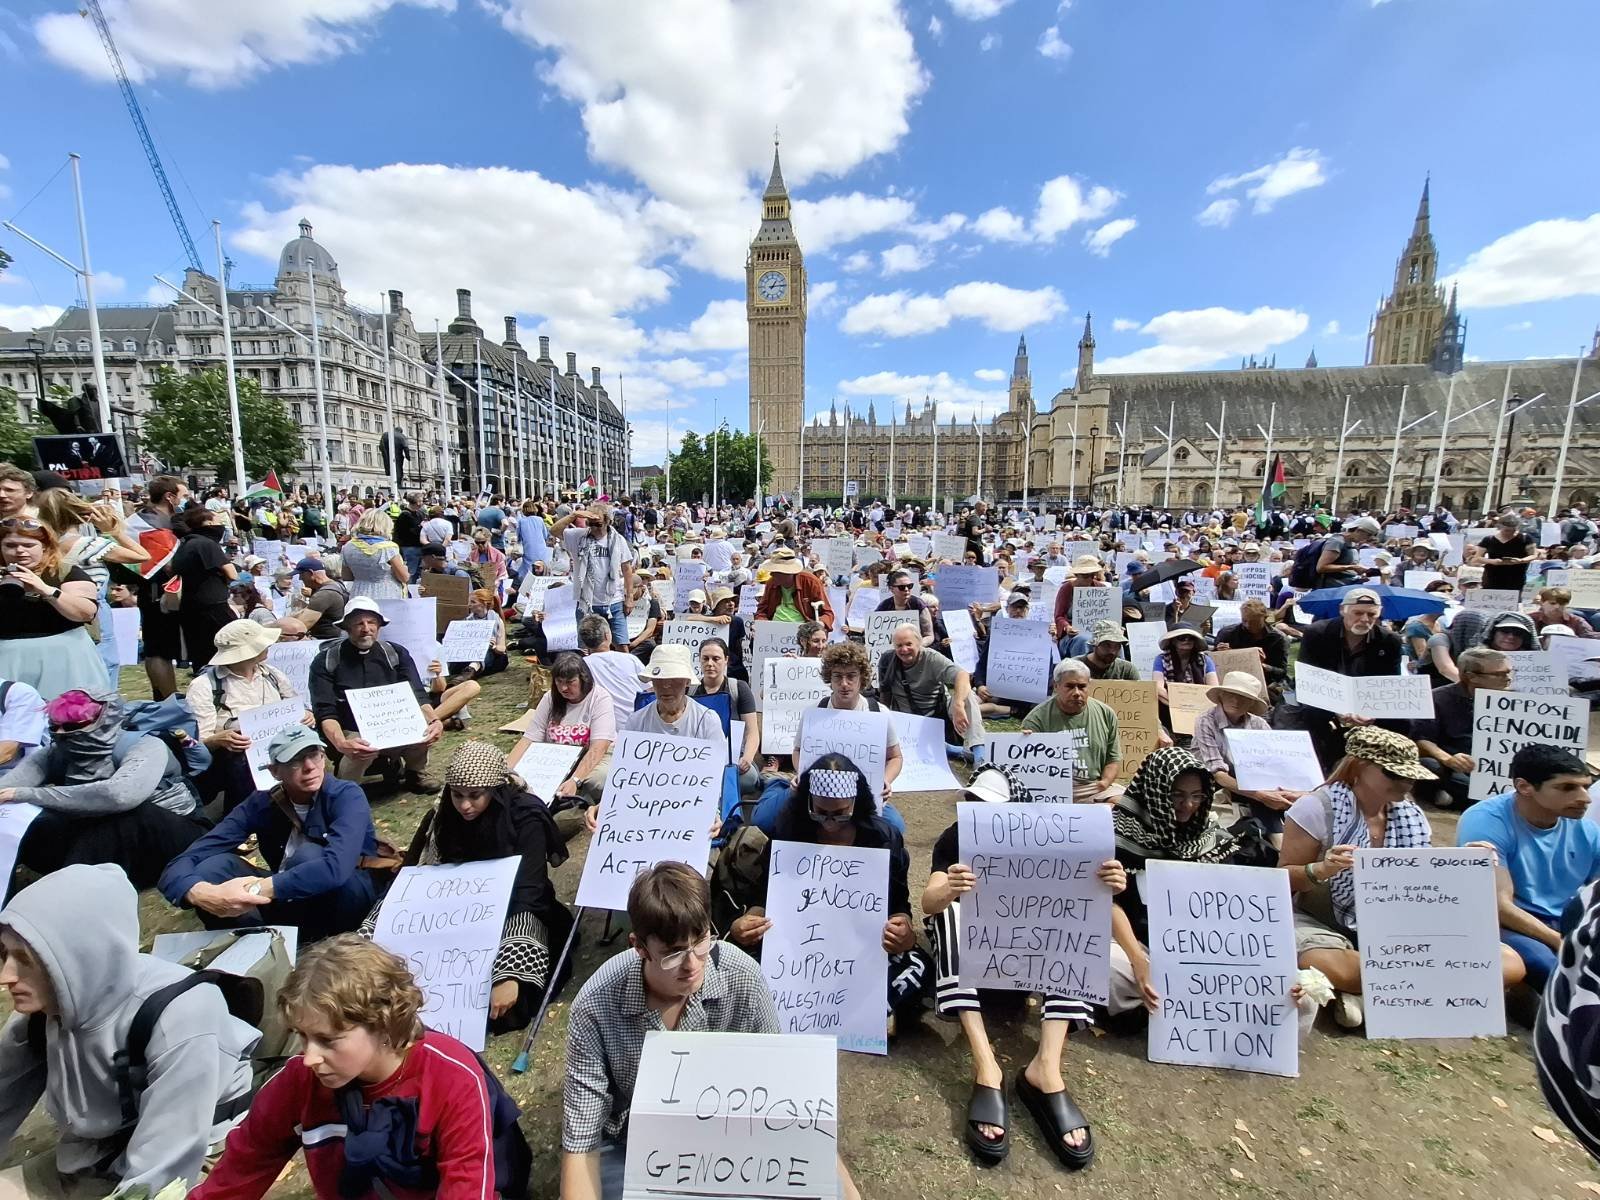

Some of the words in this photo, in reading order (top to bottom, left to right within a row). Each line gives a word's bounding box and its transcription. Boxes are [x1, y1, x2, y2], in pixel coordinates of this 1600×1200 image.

[1078, 599, 1108, 608] GENOCIDE
[1079, 589, 1082, 598] I
[1086, 589, 1110, 598] OPPOSE
[1084, 608, 1110, 616] SUPPORT
[668, 625, 671, 634] I
[677, 626, 717, 636] OPPOSE
[868, 616, 870, 630] I
[769, 662, 778, 688] I
[992, 662, 1044, 676] PALESTINE
[998, 673, 1039, 685] ACTION
[1366, 678, 1424, 688] SUPPORT
[1529, 687, 1568, 696] ACTION
[1093, 687, 1150, 704] OPPOSE
[1357, 688, 1428, 700] PALESTINE
[263, 704, 297, 720] OPPOSE
[768, 709, 777, 721] I
[1117, 710, 1141, 720] CIDE
[1361, 701, 1421, 710] ACTION
[1486, 696, 1490, 710] I
[1498, 697, 1576, 720] OPPOSE
[376, 726, 418, 740] ACTION
[822, 719, 870, 734] OPPOSE
[1476, 716, 1583, 744] GENOCIDE
[622, 738, 627, 758] I
[634, 740, 712, 766] OPPOSE
[802, 736, 882, 764] GENOCIDE
[991, 742, 996, 763] I
[1008, 743, 1072, 760] OPPOSE
[1486, 738, 1491, 752] I
[612, 768, 714, 790] GENOCIDE
[1010, 764, 1070, 778] ENOCIDE
[610, 794, 616, 808] I
[626, 794, 704, 816] Support
[598, 824, 694, 846] PALESTINE
[973, 810, 978, 846] I
[992, 812, 1084, 847] OPPOSE
[772, 850, 781, 876] I
[796, 854, 864, 882] OPPOSE
[972, 854, 1092, 884] GENOCIDE
[1362, 857, 1364, 869] I
[1372, 857, 1420, 868] OPPOSE
[1430, 858, 1490, 870] GENOCIDE
[392, 874, 422, 903] I
[426, 878, 496, 900] OPPOSE
[975, 892, 980, 918] I
[996, 894, 1094, 922] SUPPORT
[1167, 889, 1172, 916] I
[1188, 891, 1280, 923] OPPOSE
[392, 902, 496, 936] GENOCIDE
[800, 924, 824, 945] I
[968, 926, 1102, 958] PALESTINE
[1162, 928, 1277, 958] GENOCIDE
[1368, 946, 1371, 958] I
[1380, 944, 1432, 955] SUPPORT
[410, 948, 493, 982] SUPPORT
[771, 952, 856, 984] SUPPORT
[1365, 960, 1436, 969] PALESTINE
[1444, 960, 1492, 969] ACTION
[1014, 980, 1031, 989] THIS
[1054, 986, 1097, 1000] HAITHAM
[1164, 972, 1170, 996] I
[1188, 974, 1288, 996] SUPPORT
[1164, 998, 1285, 1026] PALESTINE
[1372, 996, 1434, 1008] PALESTINE
[1446, 998, 1489, 1008] ACTION
[1167, 1027, 1274, 1058] ACTION
[661, 1050, 690, 1104] I
[696, 1084, 836, 1140] OPPOSE
[646, 1150, 809, 1187] GENOCIDE
